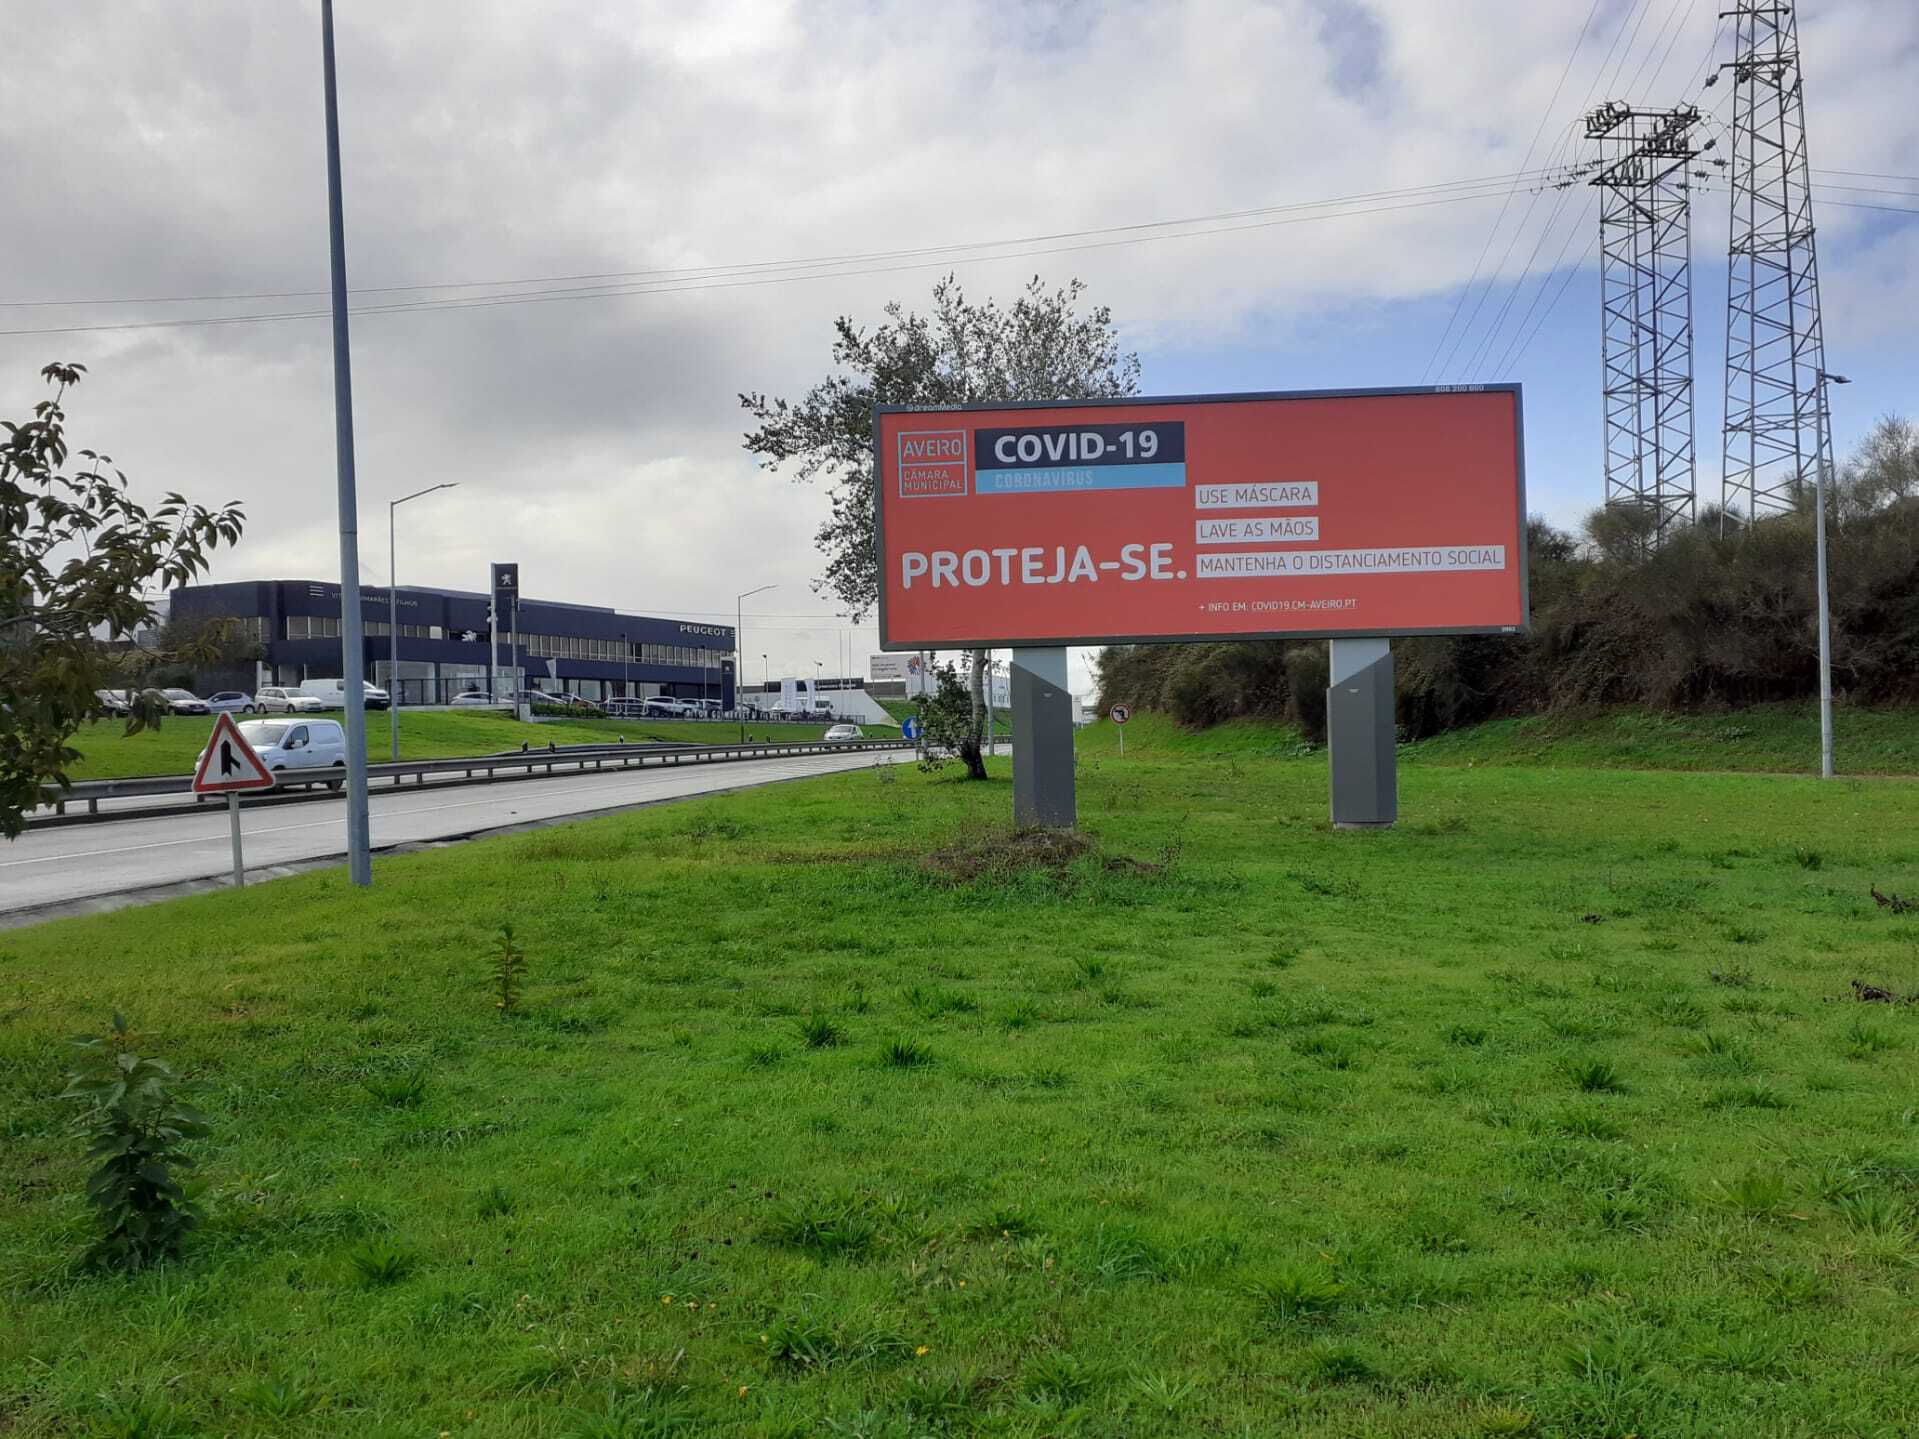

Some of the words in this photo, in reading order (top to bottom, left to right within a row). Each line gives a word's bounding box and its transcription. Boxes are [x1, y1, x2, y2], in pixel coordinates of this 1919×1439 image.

[903, 439, 962, 457] AVEIRO
[994, 430, 1159, 463] COVID-19
[904, 479, 963, 490] MUNICIPAL
[1199, 489, 1229, 504] USE
[1235, 485, 1312, 502] MÁSCARA
[1200, 523, 1237, 538] LAVE
[1244, 522, 1263, 537] AS
[1270, 519, 1314, 537] MÃOS
[902, 543, 1187, 589] PROTEJA-SE.
[1200, 556, 1287, 572] MANTENHA
[1293, 555, 1303, 570] O
[1310, 551, 1442, 569] DISTANCIAMENTO
[1448, 549, 1502, 564] SOCIAL
[1208, 602, 1229, 612] INFO
[680, 624, 727, 637] PEUGEOT
